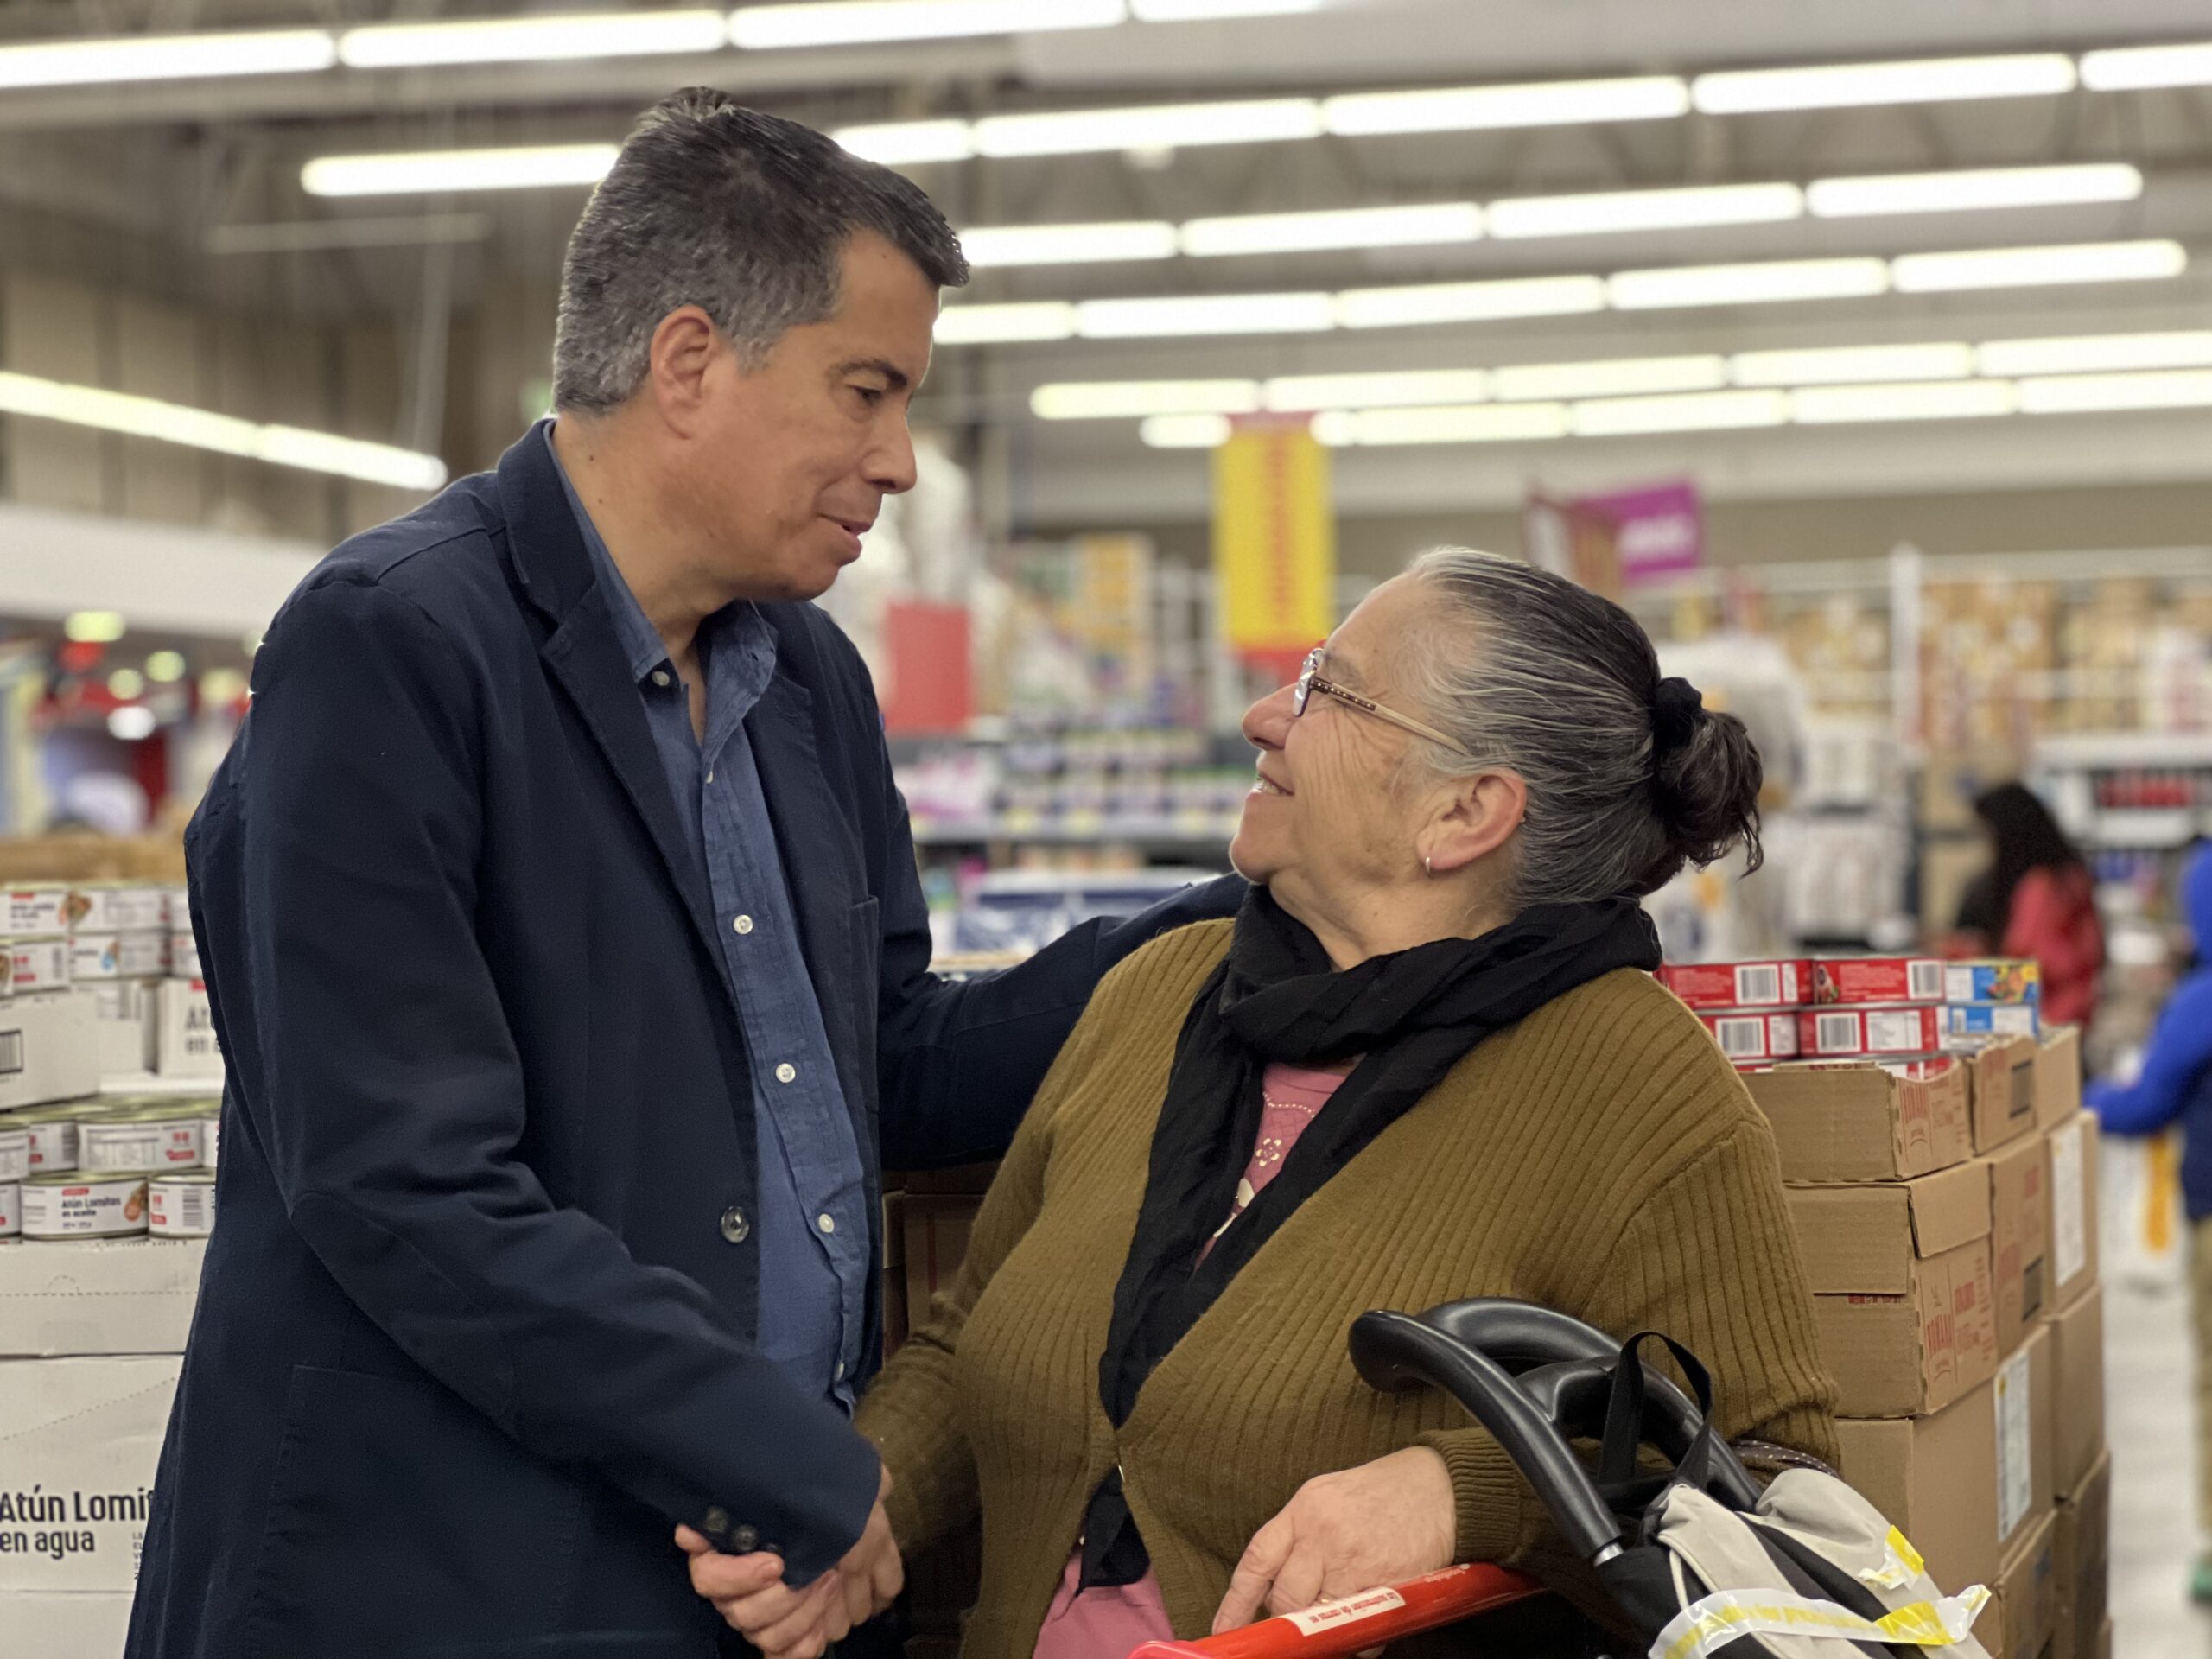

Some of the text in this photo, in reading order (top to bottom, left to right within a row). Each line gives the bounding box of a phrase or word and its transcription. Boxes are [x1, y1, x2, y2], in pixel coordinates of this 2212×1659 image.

[0, 1484, 65, 1522] Atún
[0, 1530, 95, 1560] en agua
